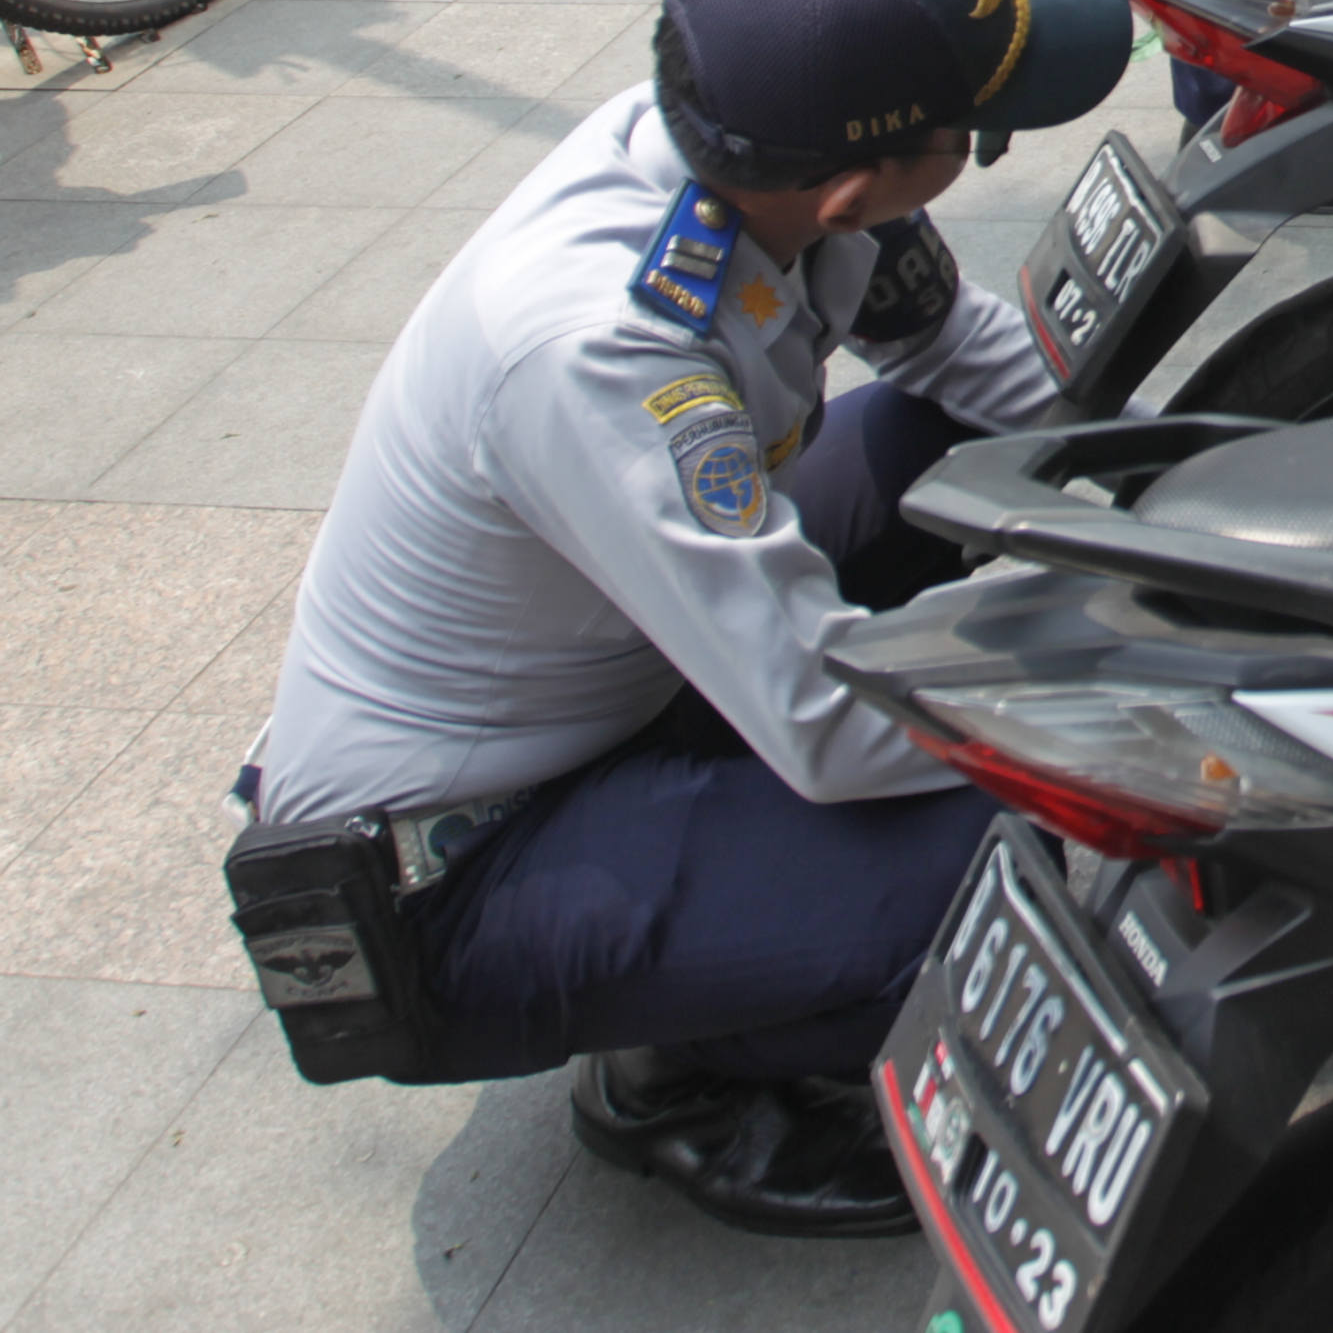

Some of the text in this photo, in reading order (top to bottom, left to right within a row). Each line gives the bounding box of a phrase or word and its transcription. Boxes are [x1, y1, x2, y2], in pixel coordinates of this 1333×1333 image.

[846, 103, 925, 141] DIKA
[1096, 218, 1151, 305] TLR
[1117, 910, 1169, 989] HONDA
[961, 916, 1065, 1097] 6176
[1046, 1045, 1154, 1227] VRU
